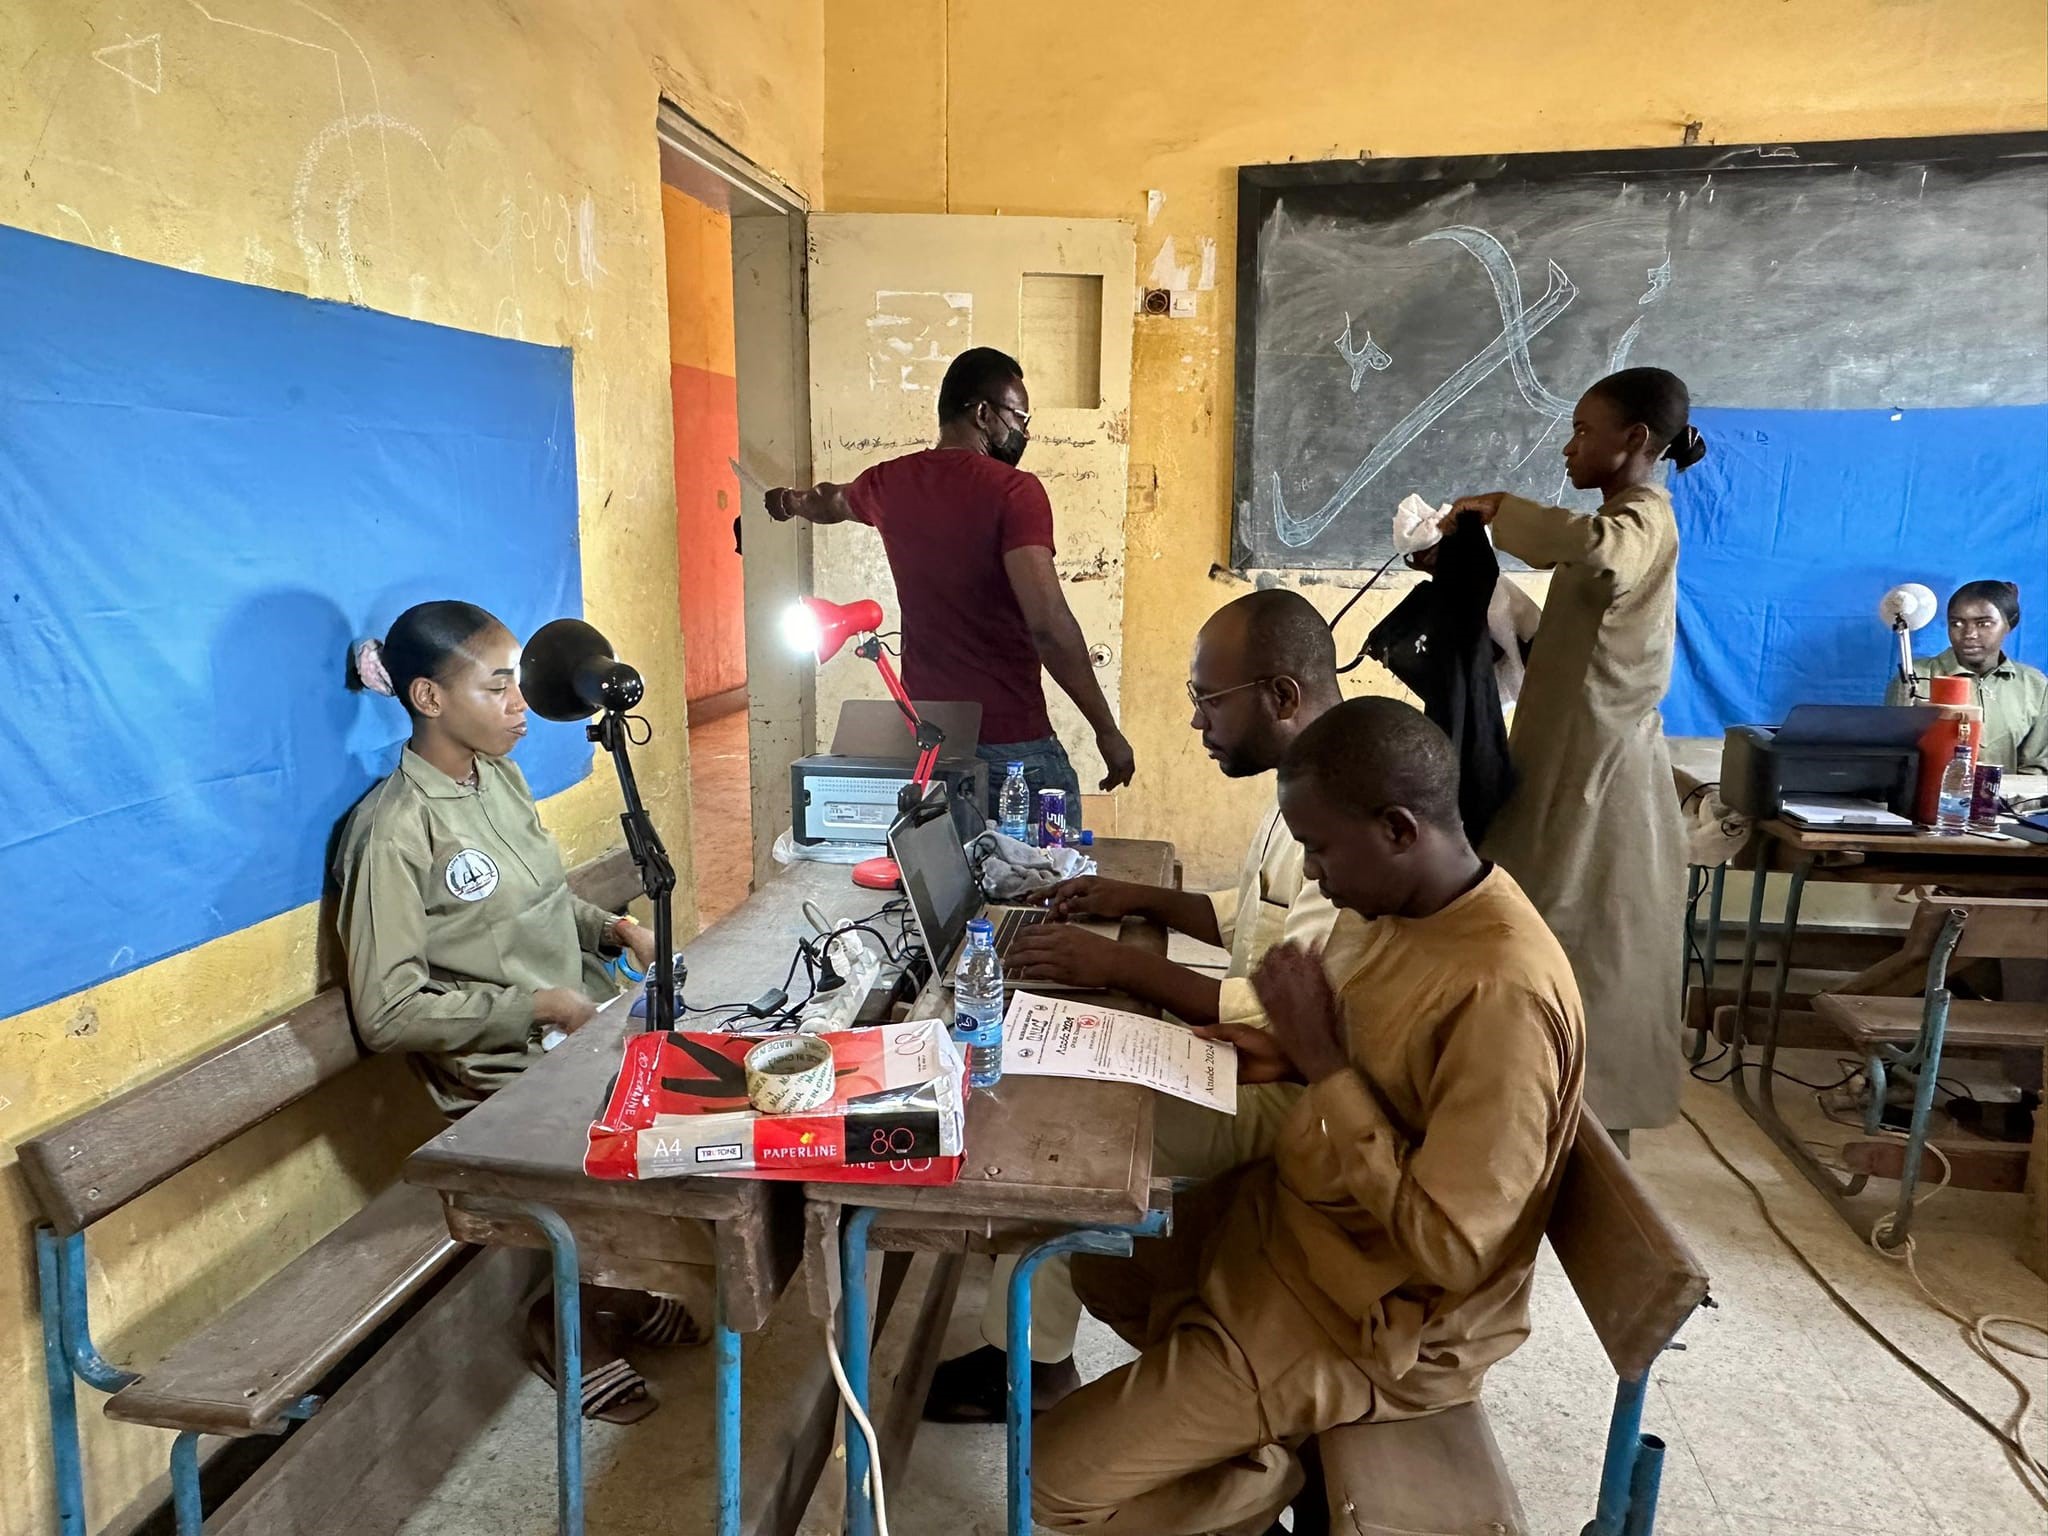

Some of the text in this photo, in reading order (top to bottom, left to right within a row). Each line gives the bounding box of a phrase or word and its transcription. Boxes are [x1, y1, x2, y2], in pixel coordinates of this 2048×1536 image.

[1205, 1044, 1214, 1095] Année 2024
[653, 1138, 682, 1158] A4
[763, 1144, 838, 1159] PAPERLINE
[870, 1127, 915, 1155] 80
